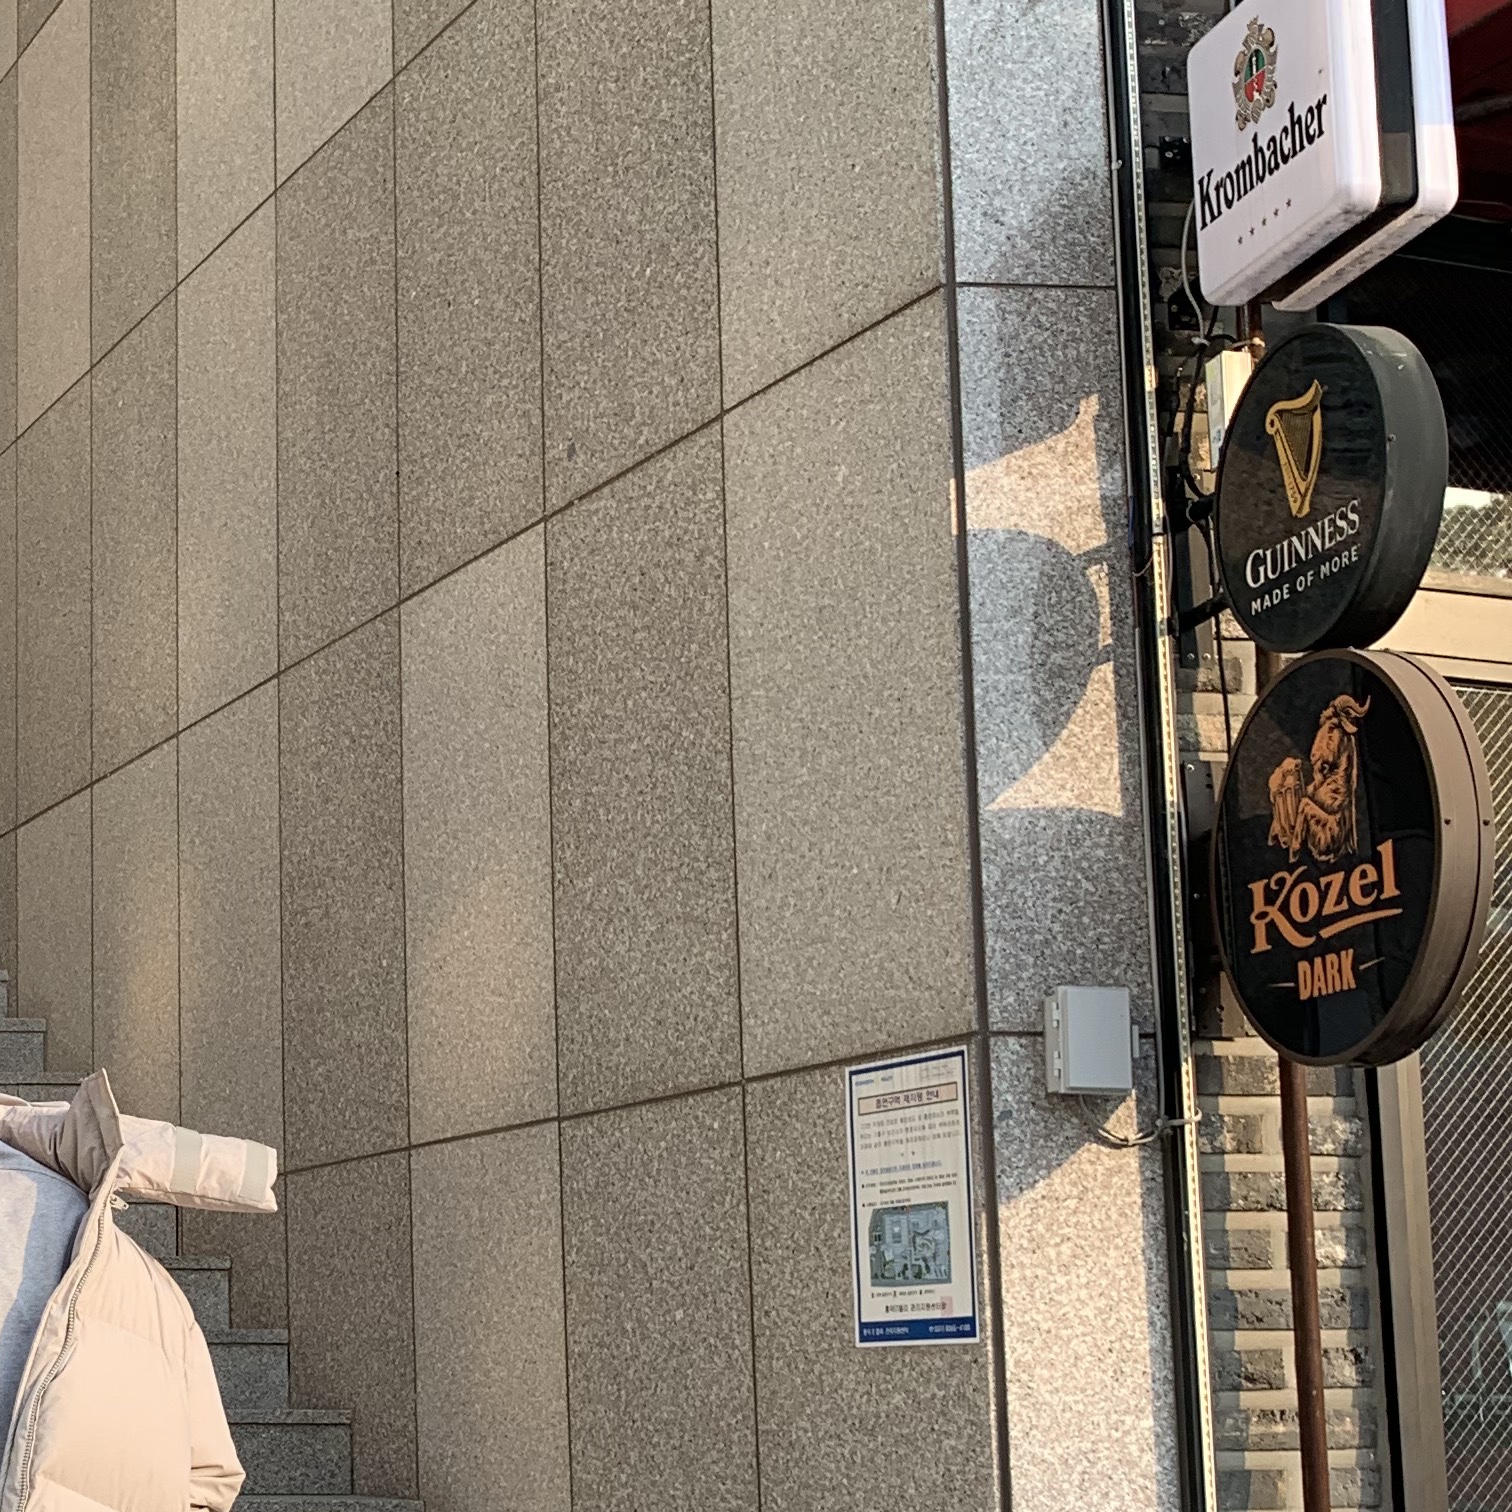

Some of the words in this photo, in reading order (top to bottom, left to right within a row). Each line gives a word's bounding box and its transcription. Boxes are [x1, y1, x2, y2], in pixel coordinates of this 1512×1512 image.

[1197, 93, 1328, 231] Krombacher
[1245, 499, 1360, 589] GUINNESS
[1251, 583, 1291, 616] MADE
[1296, 569, 1315, 592] OF
[1320, 545, 1359, 580] MORE
[1248, 838, 1402, 954] Kozel
[1297, 948, 1357, 1001] DARK
